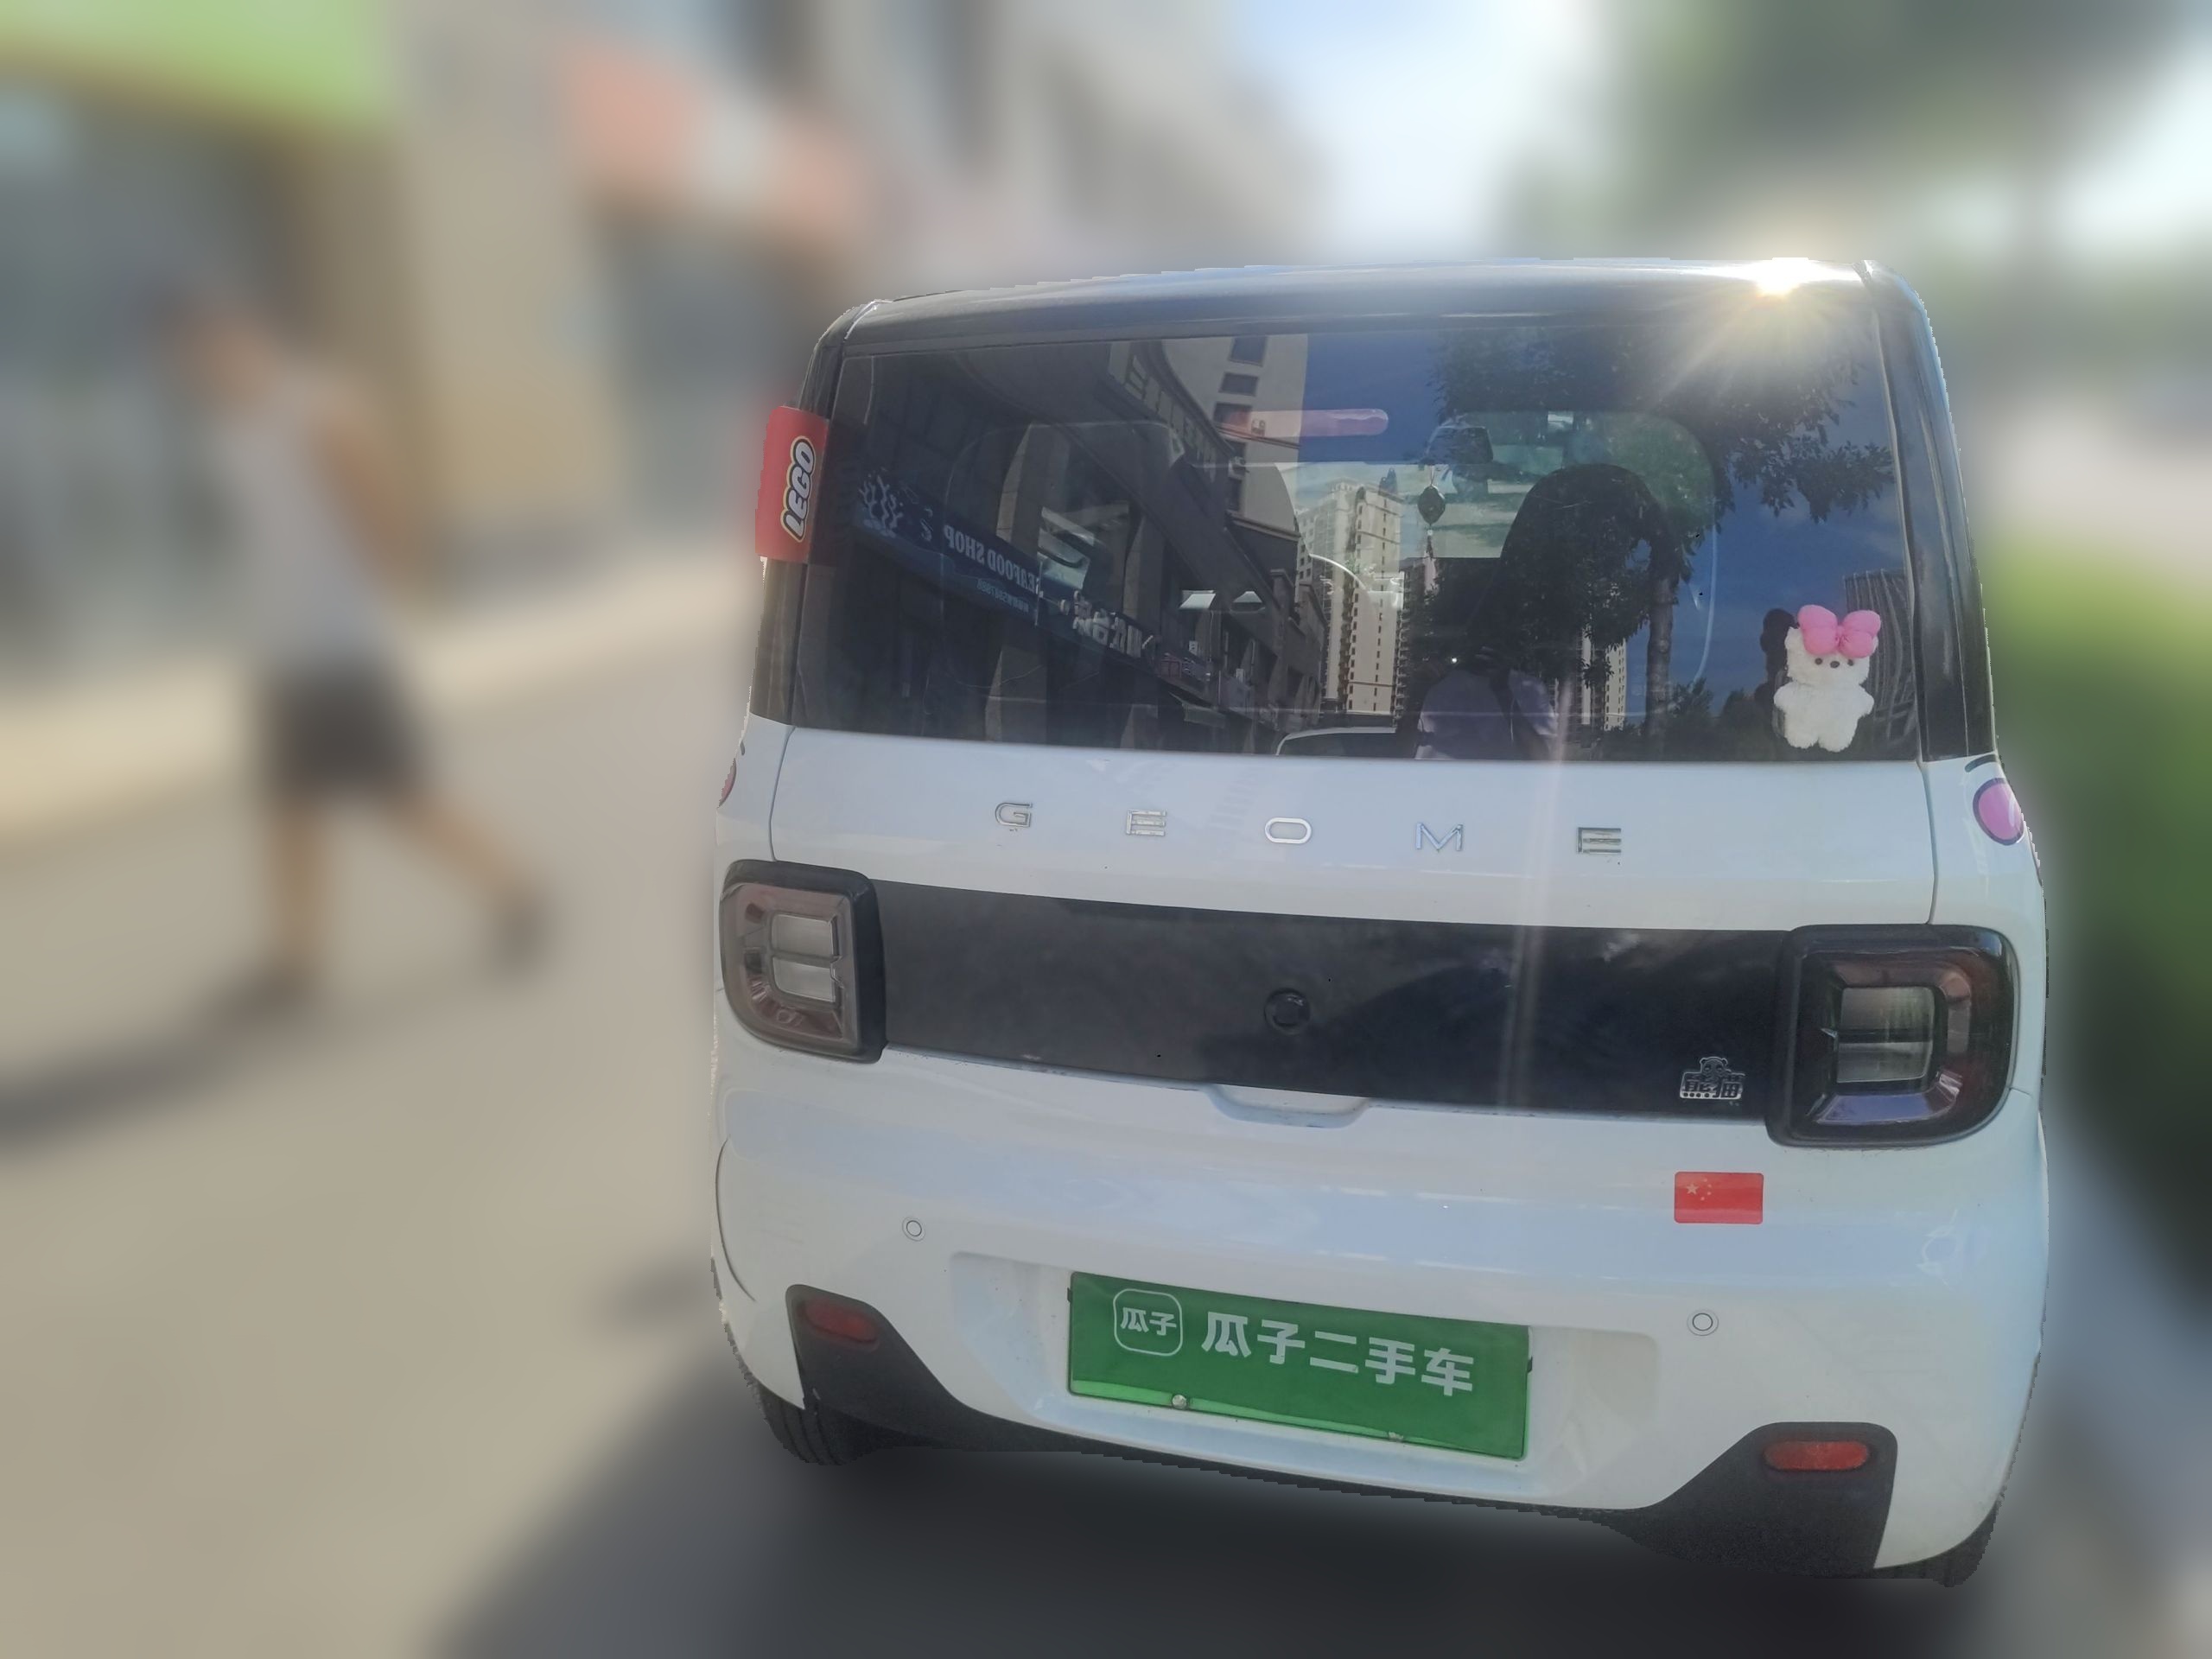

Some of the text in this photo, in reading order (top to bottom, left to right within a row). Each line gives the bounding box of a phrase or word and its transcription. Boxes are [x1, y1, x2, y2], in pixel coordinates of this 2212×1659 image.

[782, 437, 816, 541] LEGO
[995, 801, 1622, 855] GEOME
[1120, 1306, 1475, 1397] 瓜子 瓜子二手车
